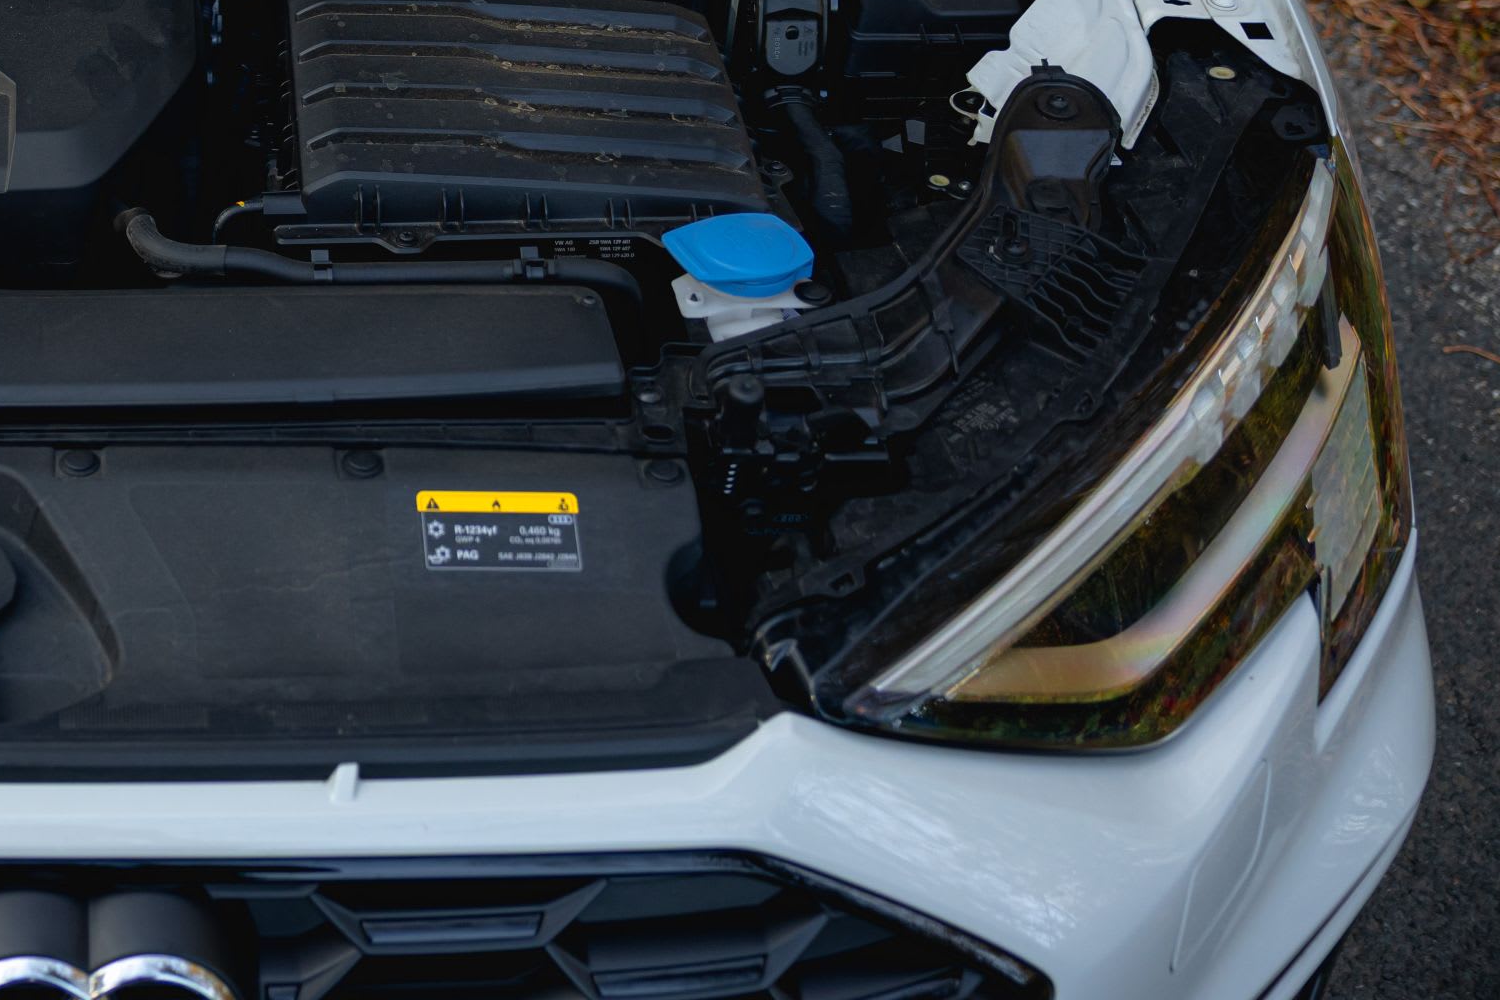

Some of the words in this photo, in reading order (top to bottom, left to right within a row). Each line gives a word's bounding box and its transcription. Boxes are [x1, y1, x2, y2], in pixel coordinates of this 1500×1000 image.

[454, 524, 498, 536] R-1234yf
[548, 526, 561, 537] kg
[456, 549, 480, 560] PAG
